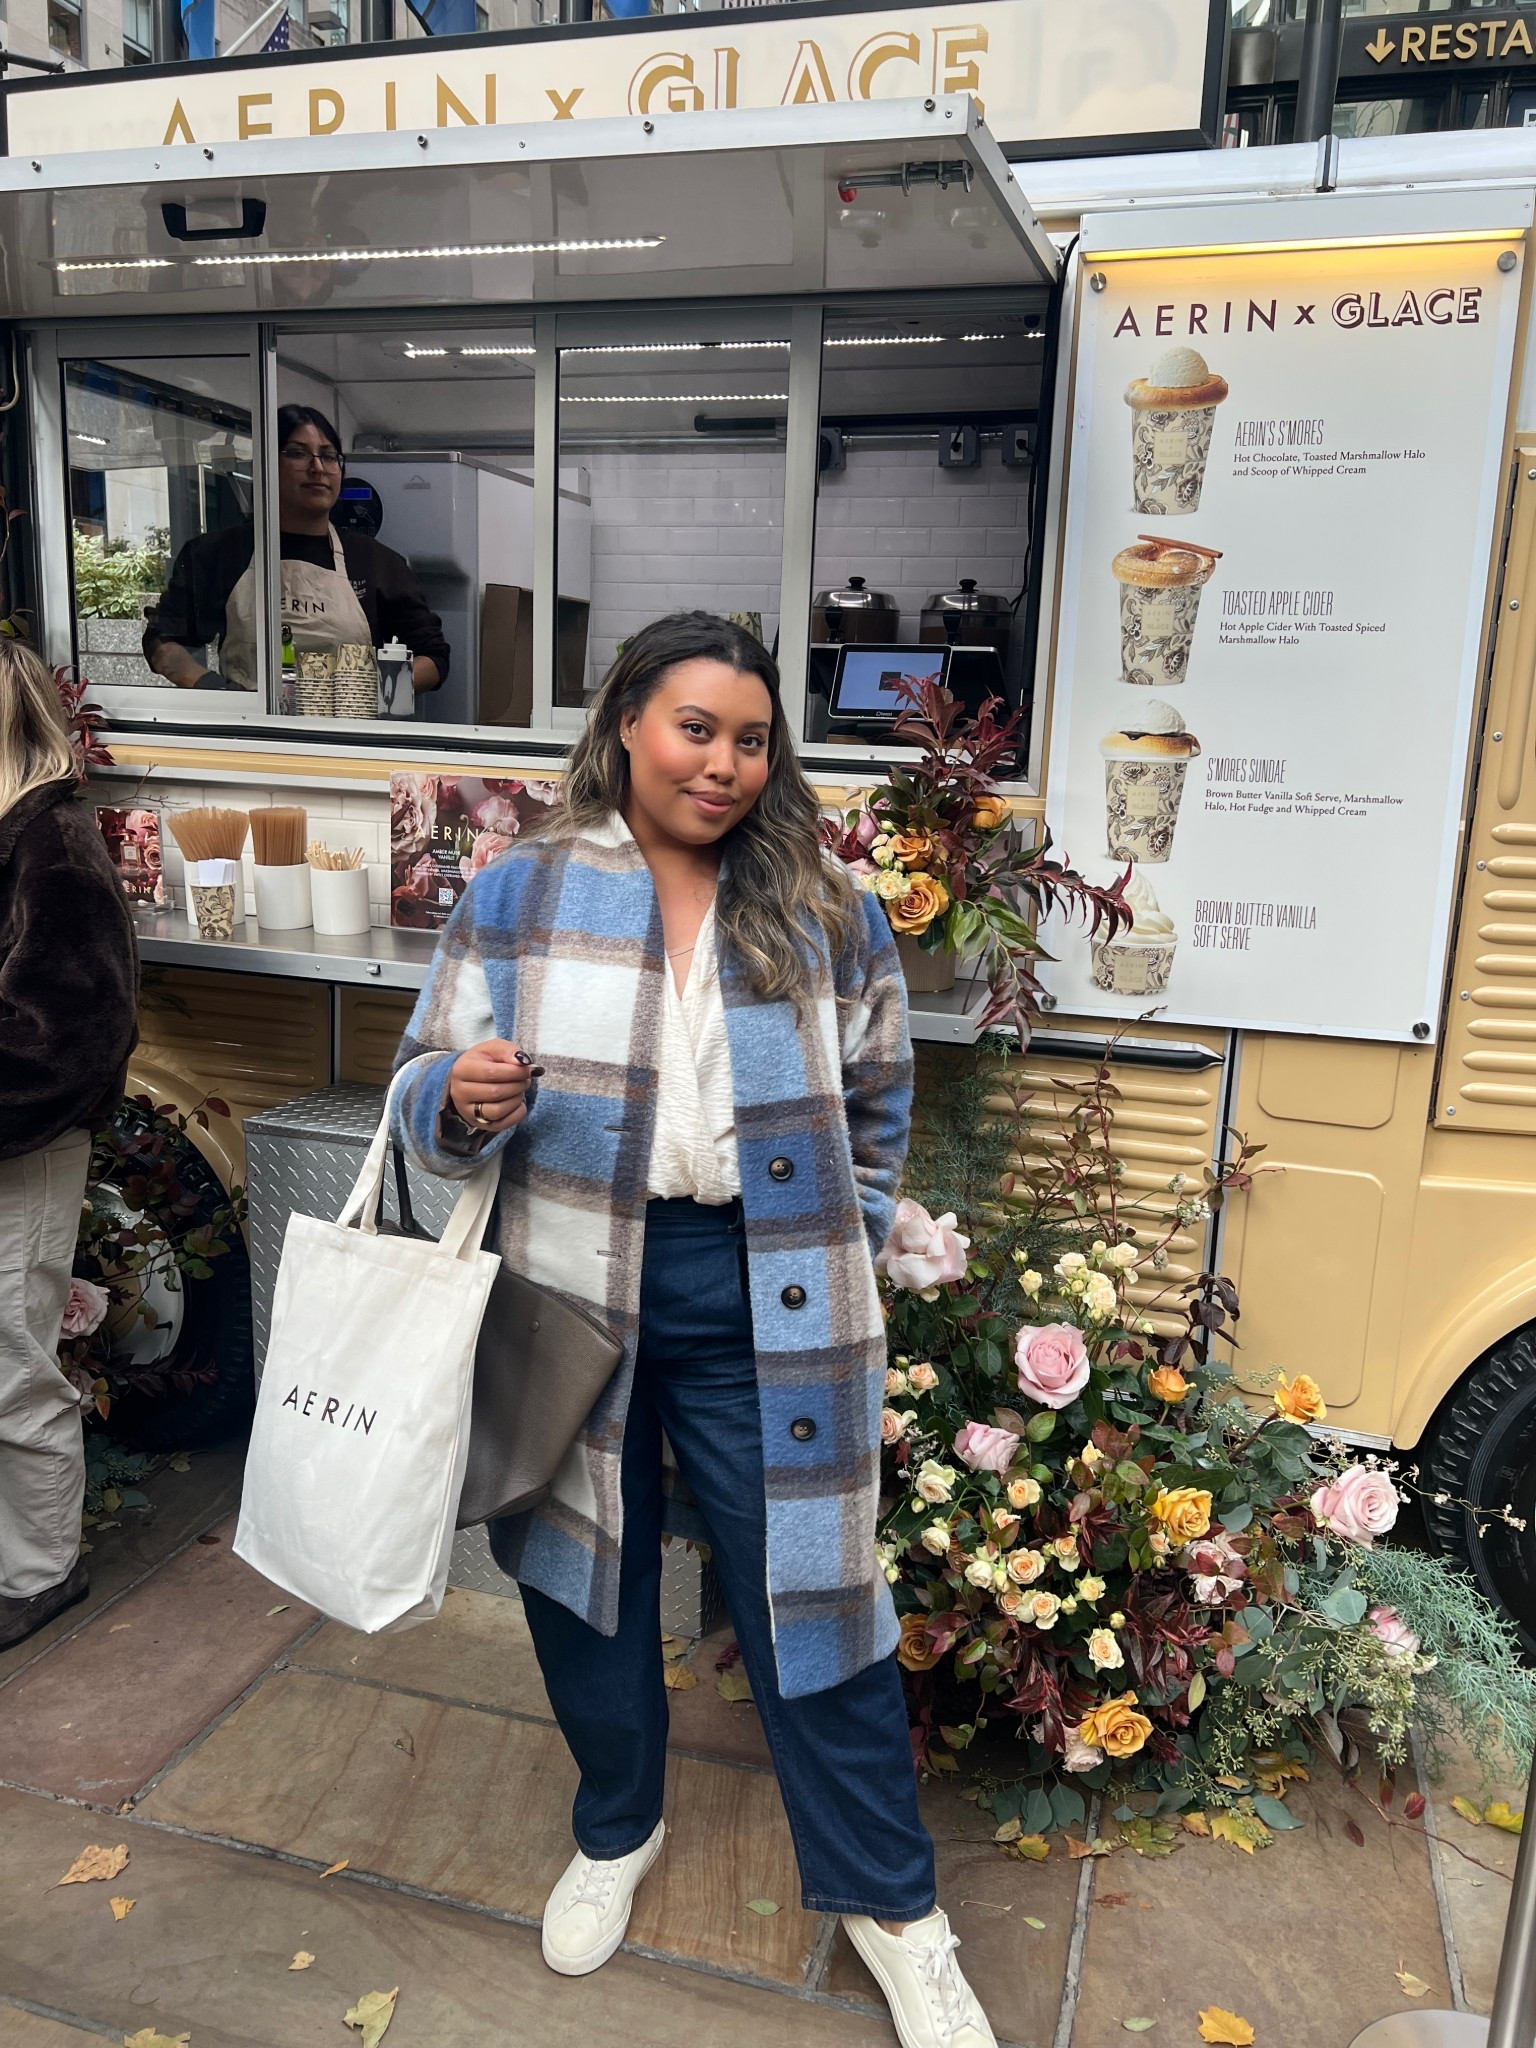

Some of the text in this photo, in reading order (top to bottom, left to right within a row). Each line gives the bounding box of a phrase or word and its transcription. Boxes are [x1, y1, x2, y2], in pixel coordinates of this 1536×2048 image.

[1113, 299, 1277, 338] AERIN
[1331, 286, 1482, 329] GLACE
[1234, 419, 1324, 447] AERIN'S S'MORES
[1233, 449, 1426, 463] Hot Chocolate, Toasted Marshmallow Halo
[1232, 465, 1367, 478] and Scoop of Whipped Cream
[1222, 590, 1334, 616] TOASTED APPLE CIDER
[1219, 622, 1386, 634] Hot Apple Cider With Toasted Spiced
[1219, 635, 1300, 645] Marshmallow Halo
[1207, 757, 1287, 784] S'MORES SUNDAE
[1205, 789, 1404, 805] Brown Butter Vanilla Soft Serve, Marshmallow
[1204, 802, 1367, 817] Halo, Hot Fudge and Whipped Cream
[415, 825, 479, 842] AERIN
[1195, 899, 1316, 930] BROWN BUTTER VANILLA
[1193, 924, 1252, 951] SOFT SERVE
[282, 1384, 377, 1436] AERIN
